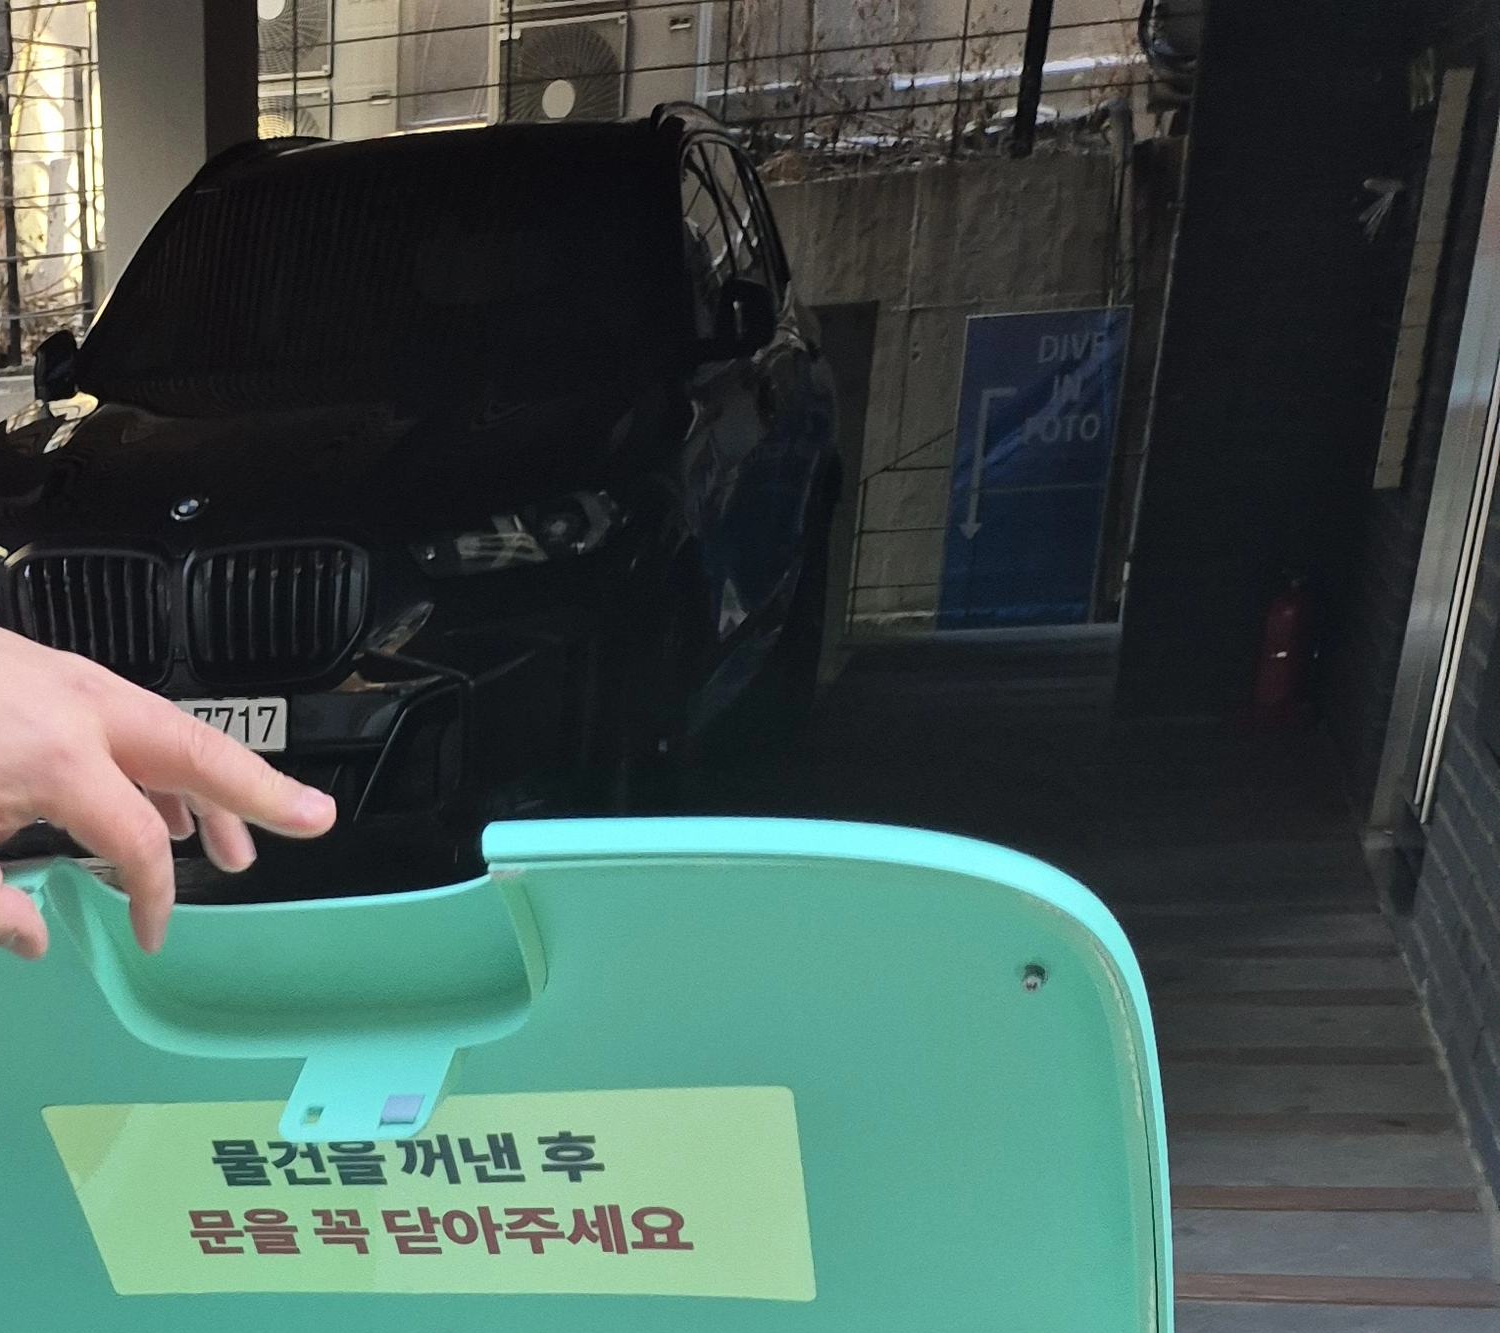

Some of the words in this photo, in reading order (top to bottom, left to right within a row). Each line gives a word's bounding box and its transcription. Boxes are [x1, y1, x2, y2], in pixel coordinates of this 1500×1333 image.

[211, 1139, 388, 1187] 물건을
[395, 1133, 526, 1184] 꺼낸
[539, 1131, 605, 1183] 후
[189, 1208, 299, 1254] 문을
[311, 1207, 370, 1255] 꼭
[382, 1205, 694, 1254] 닫아주세요
